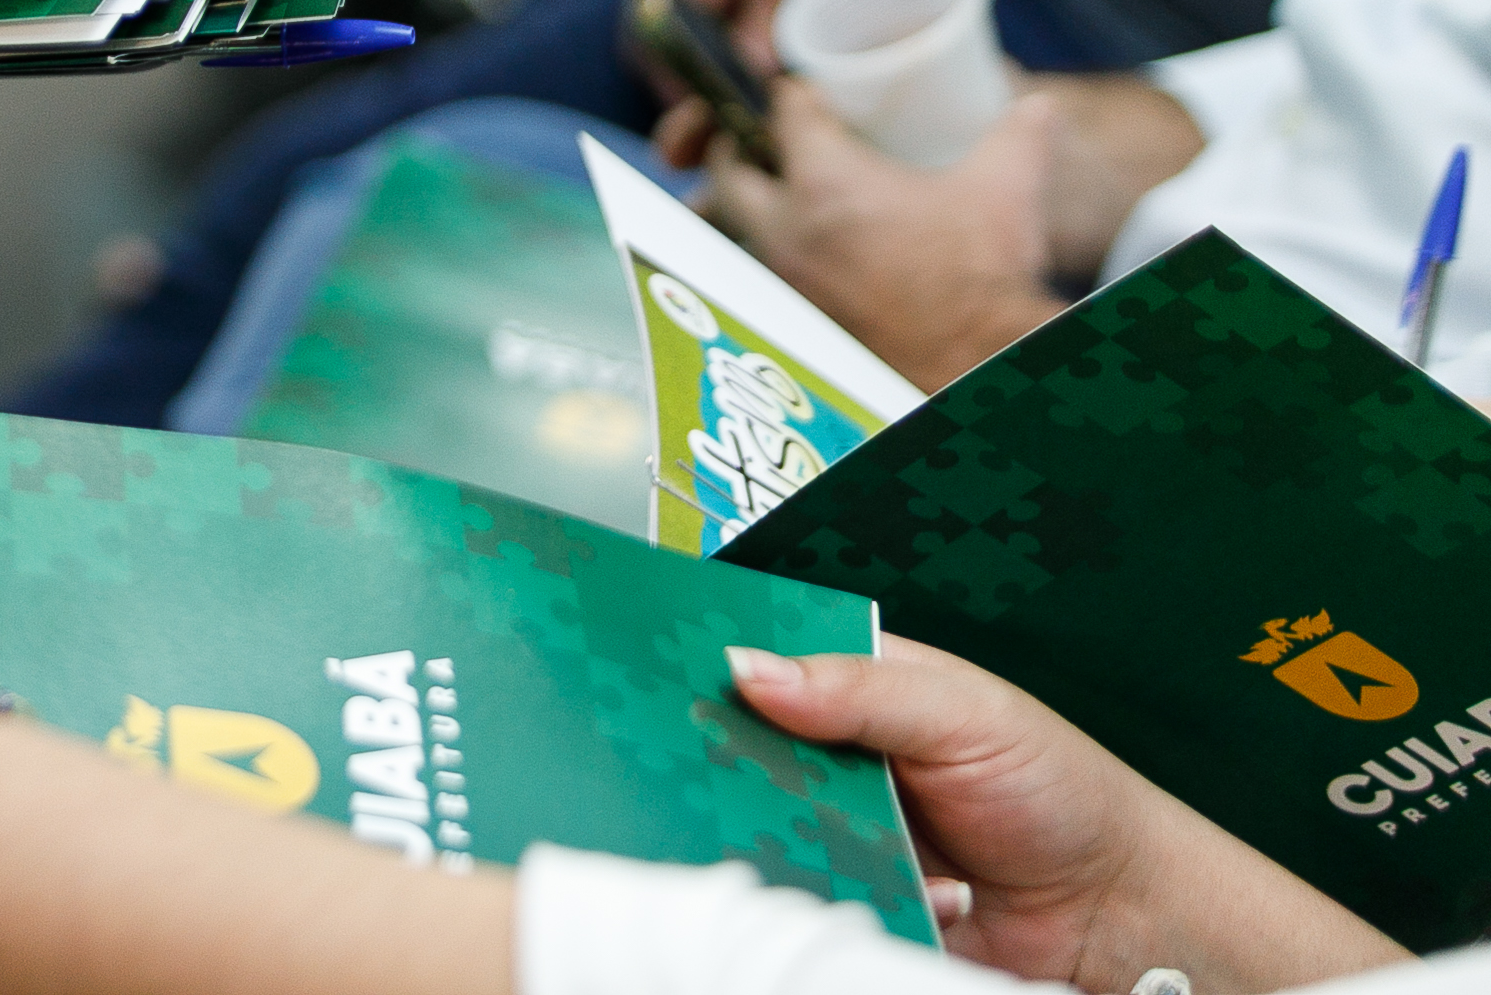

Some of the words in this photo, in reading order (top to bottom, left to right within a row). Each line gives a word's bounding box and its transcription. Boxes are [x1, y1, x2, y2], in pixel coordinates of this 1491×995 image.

[692, 351, 824, 518] tismo
[323, 649, 434, 868] UIABÁ
[423, 657, 474, 877] EFEITURA
[1326, 697, 1491, 817] CUIA
[1376, 769, 1491, 839] PREFE
